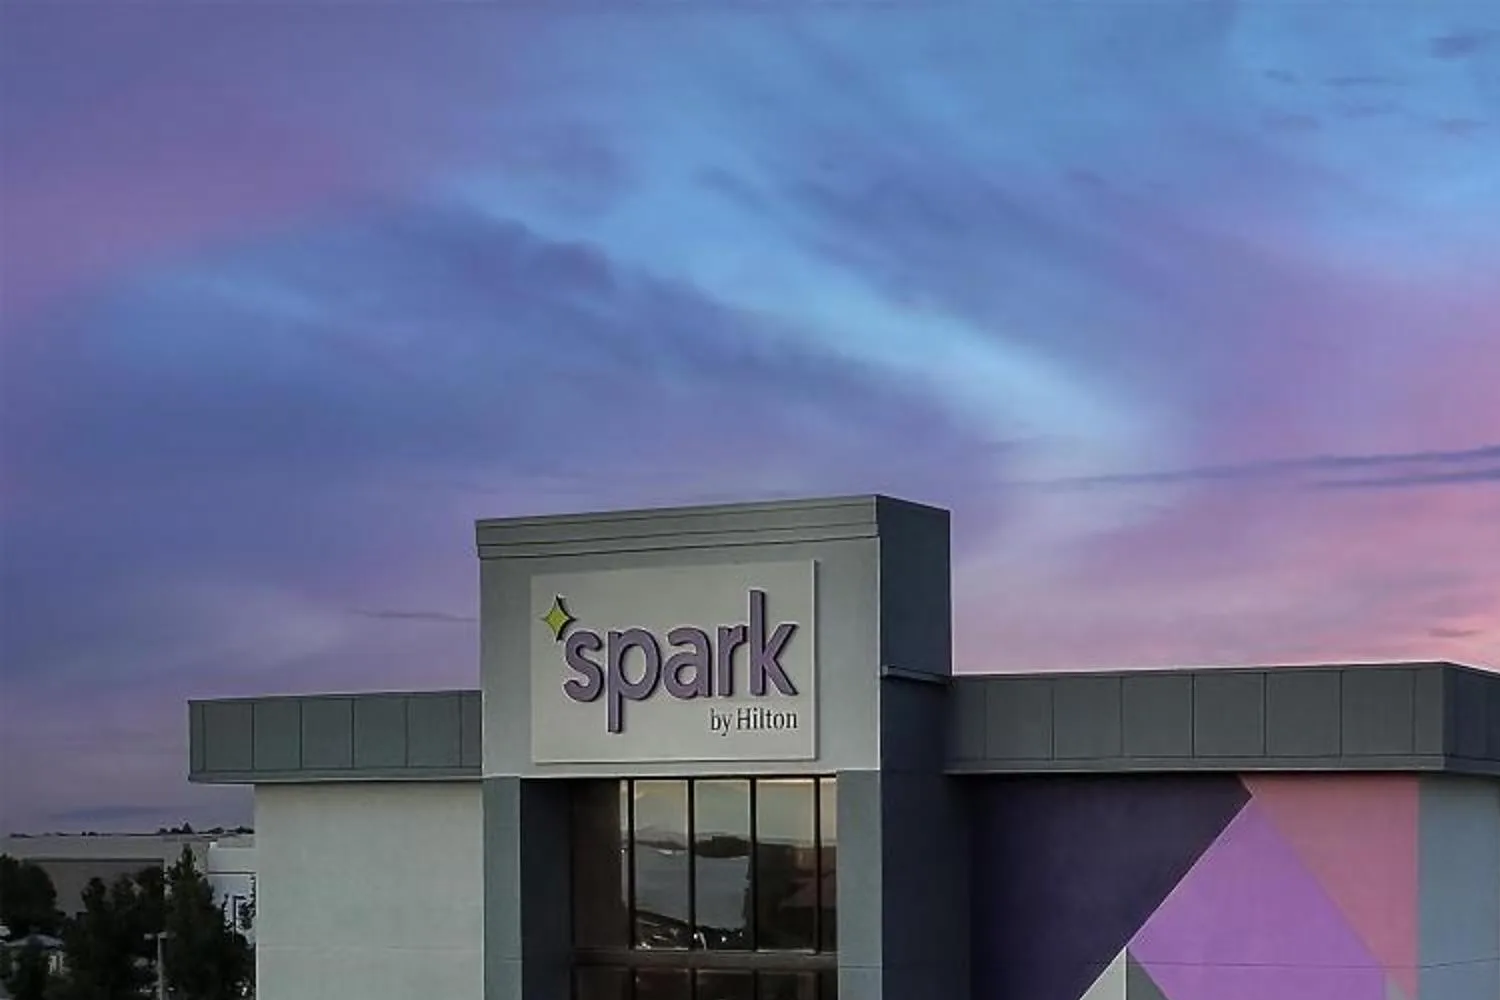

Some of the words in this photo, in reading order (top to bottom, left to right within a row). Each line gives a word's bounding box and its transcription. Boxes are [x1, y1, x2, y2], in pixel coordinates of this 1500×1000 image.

[563, 589, 799, 734] spark
[710, 707, 733, 735] by
[735, 706, 798, 731] Hilton
